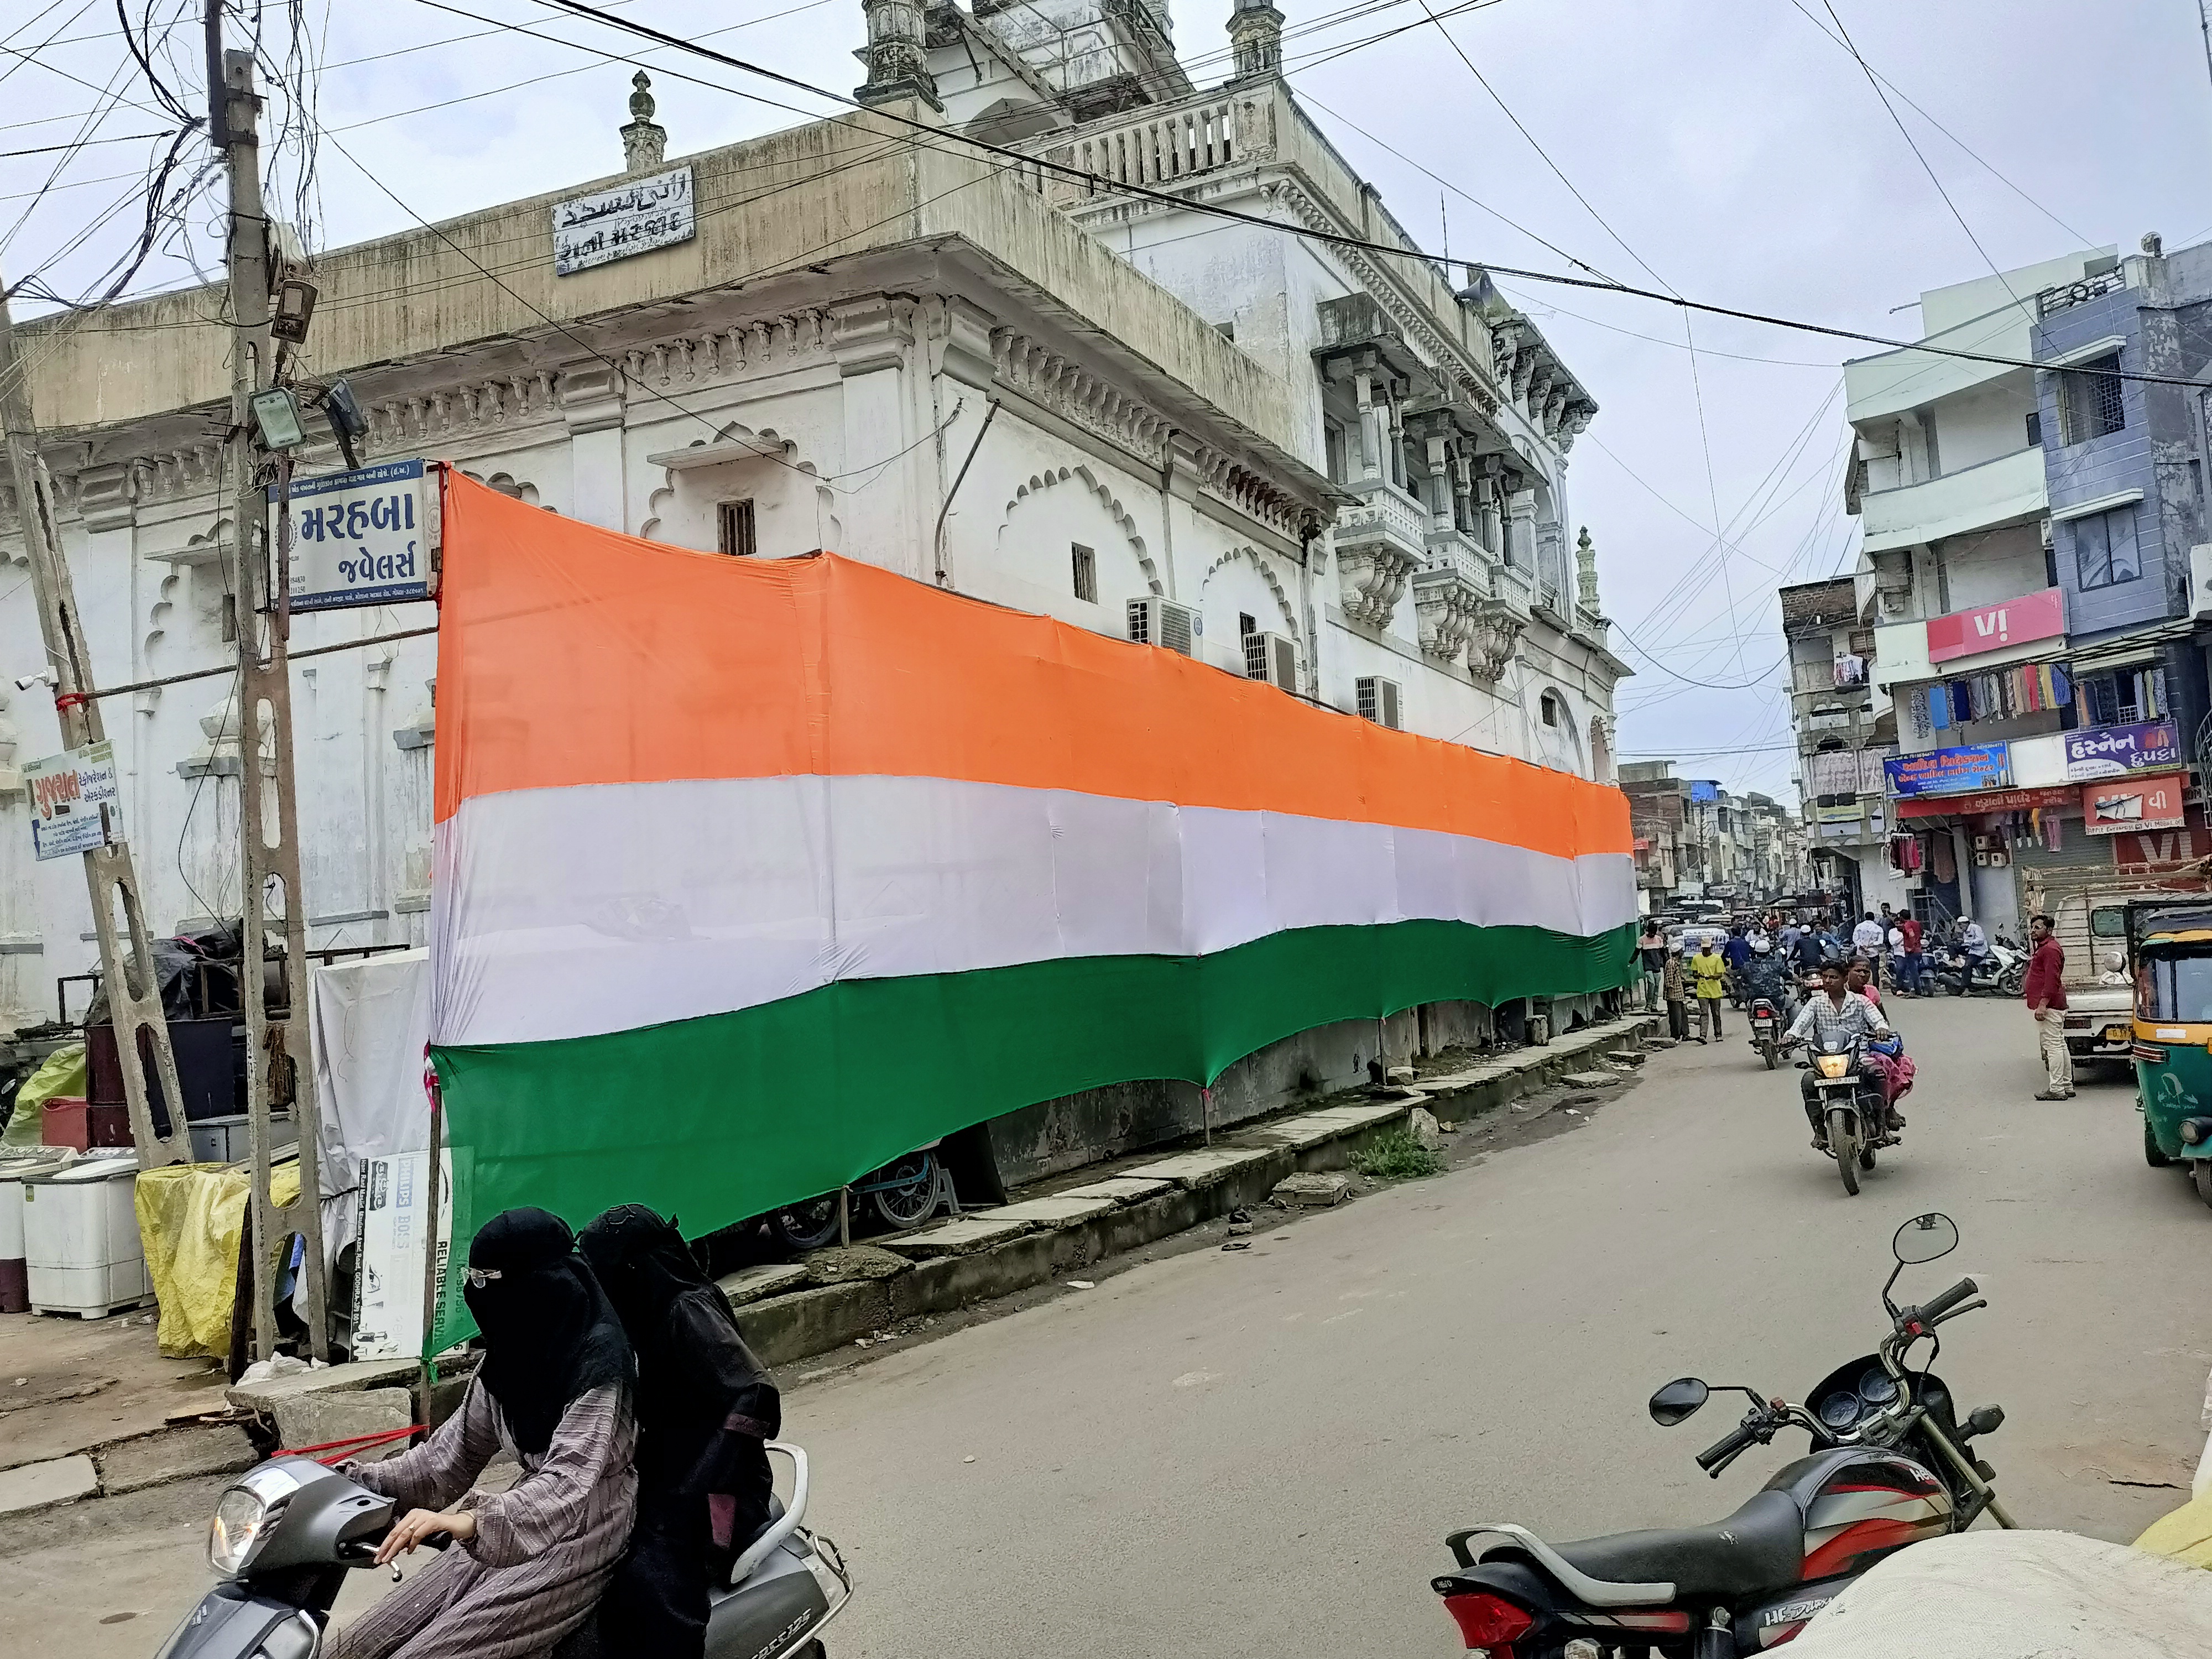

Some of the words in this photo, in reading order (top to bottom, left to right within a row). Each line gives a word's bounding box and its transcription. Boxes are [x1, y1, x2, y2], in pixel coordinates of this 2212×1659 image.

[301, 493, 415, 542] મરહબા
[338, 540, 416, 583] જવેલર્સ
[35, 769, 80, 821] ગુજરાત
[399, 1160, 411, 1206] PHILIPS
